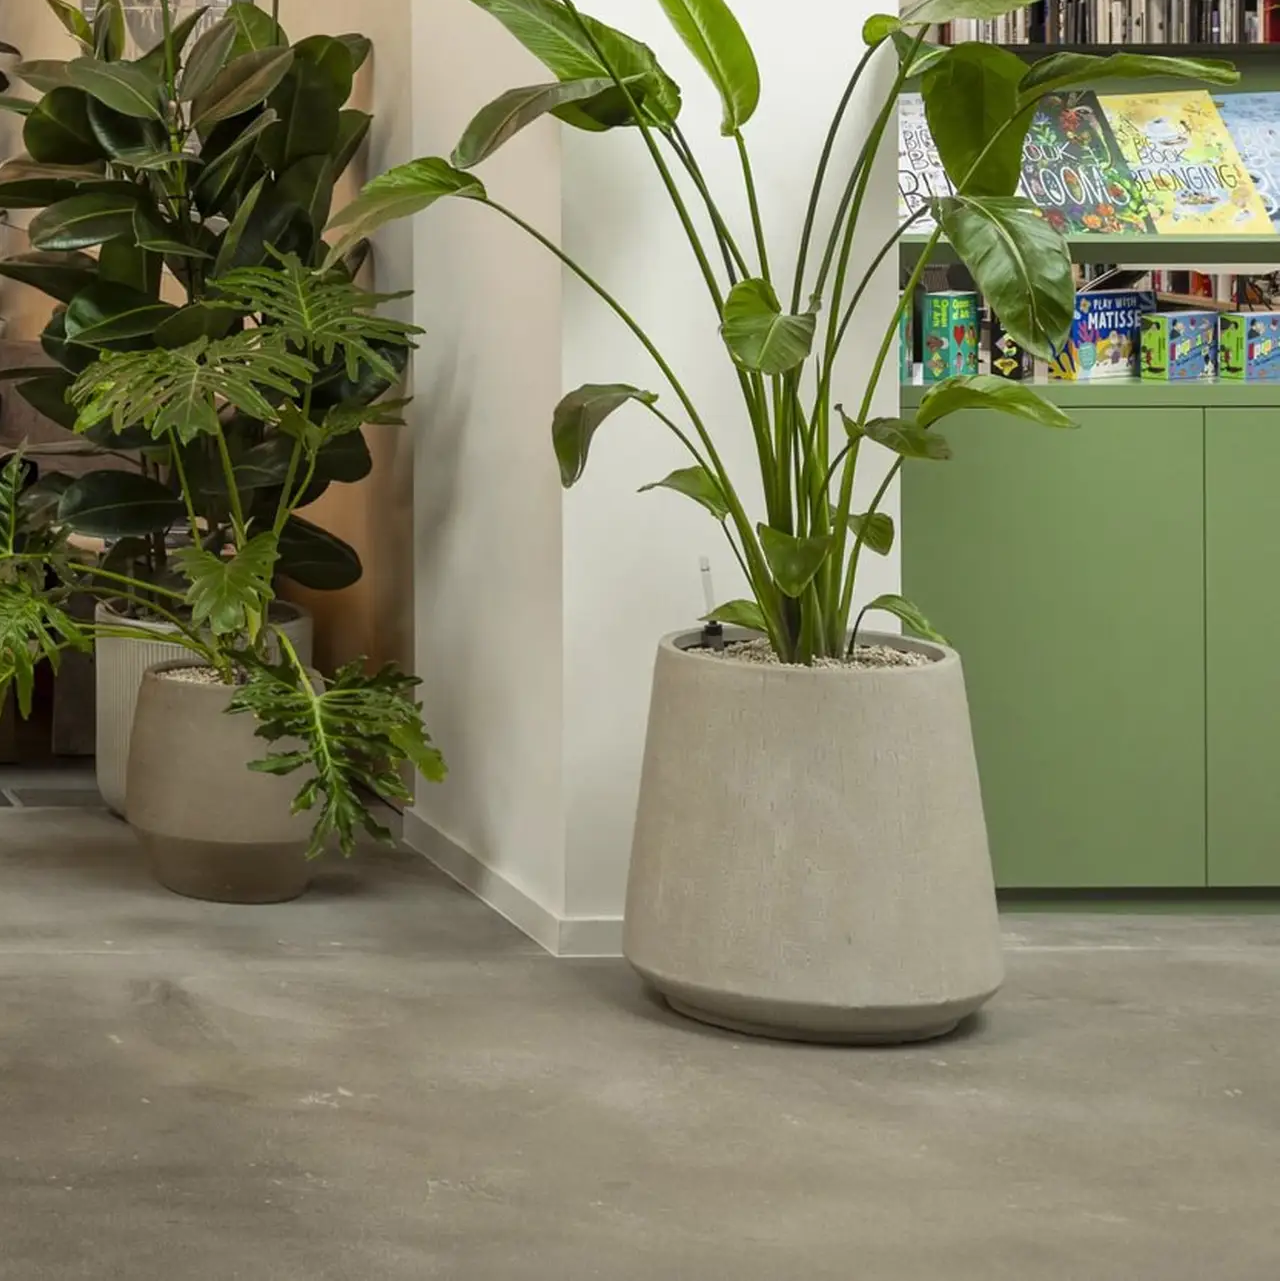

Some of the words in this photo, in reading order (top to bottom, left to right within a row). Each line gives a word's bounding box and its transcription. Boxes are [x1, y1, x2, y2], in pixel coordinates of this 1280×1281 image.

[1020, 166, 1131, 207] LOOMS
[1131, 164, 1238, 193] BELONGING
[1093, 298, 1113, 310] PLAY
[1114, 297, 1137, 309] WITH
[1088, 310, 1141, 330] MATISSE
